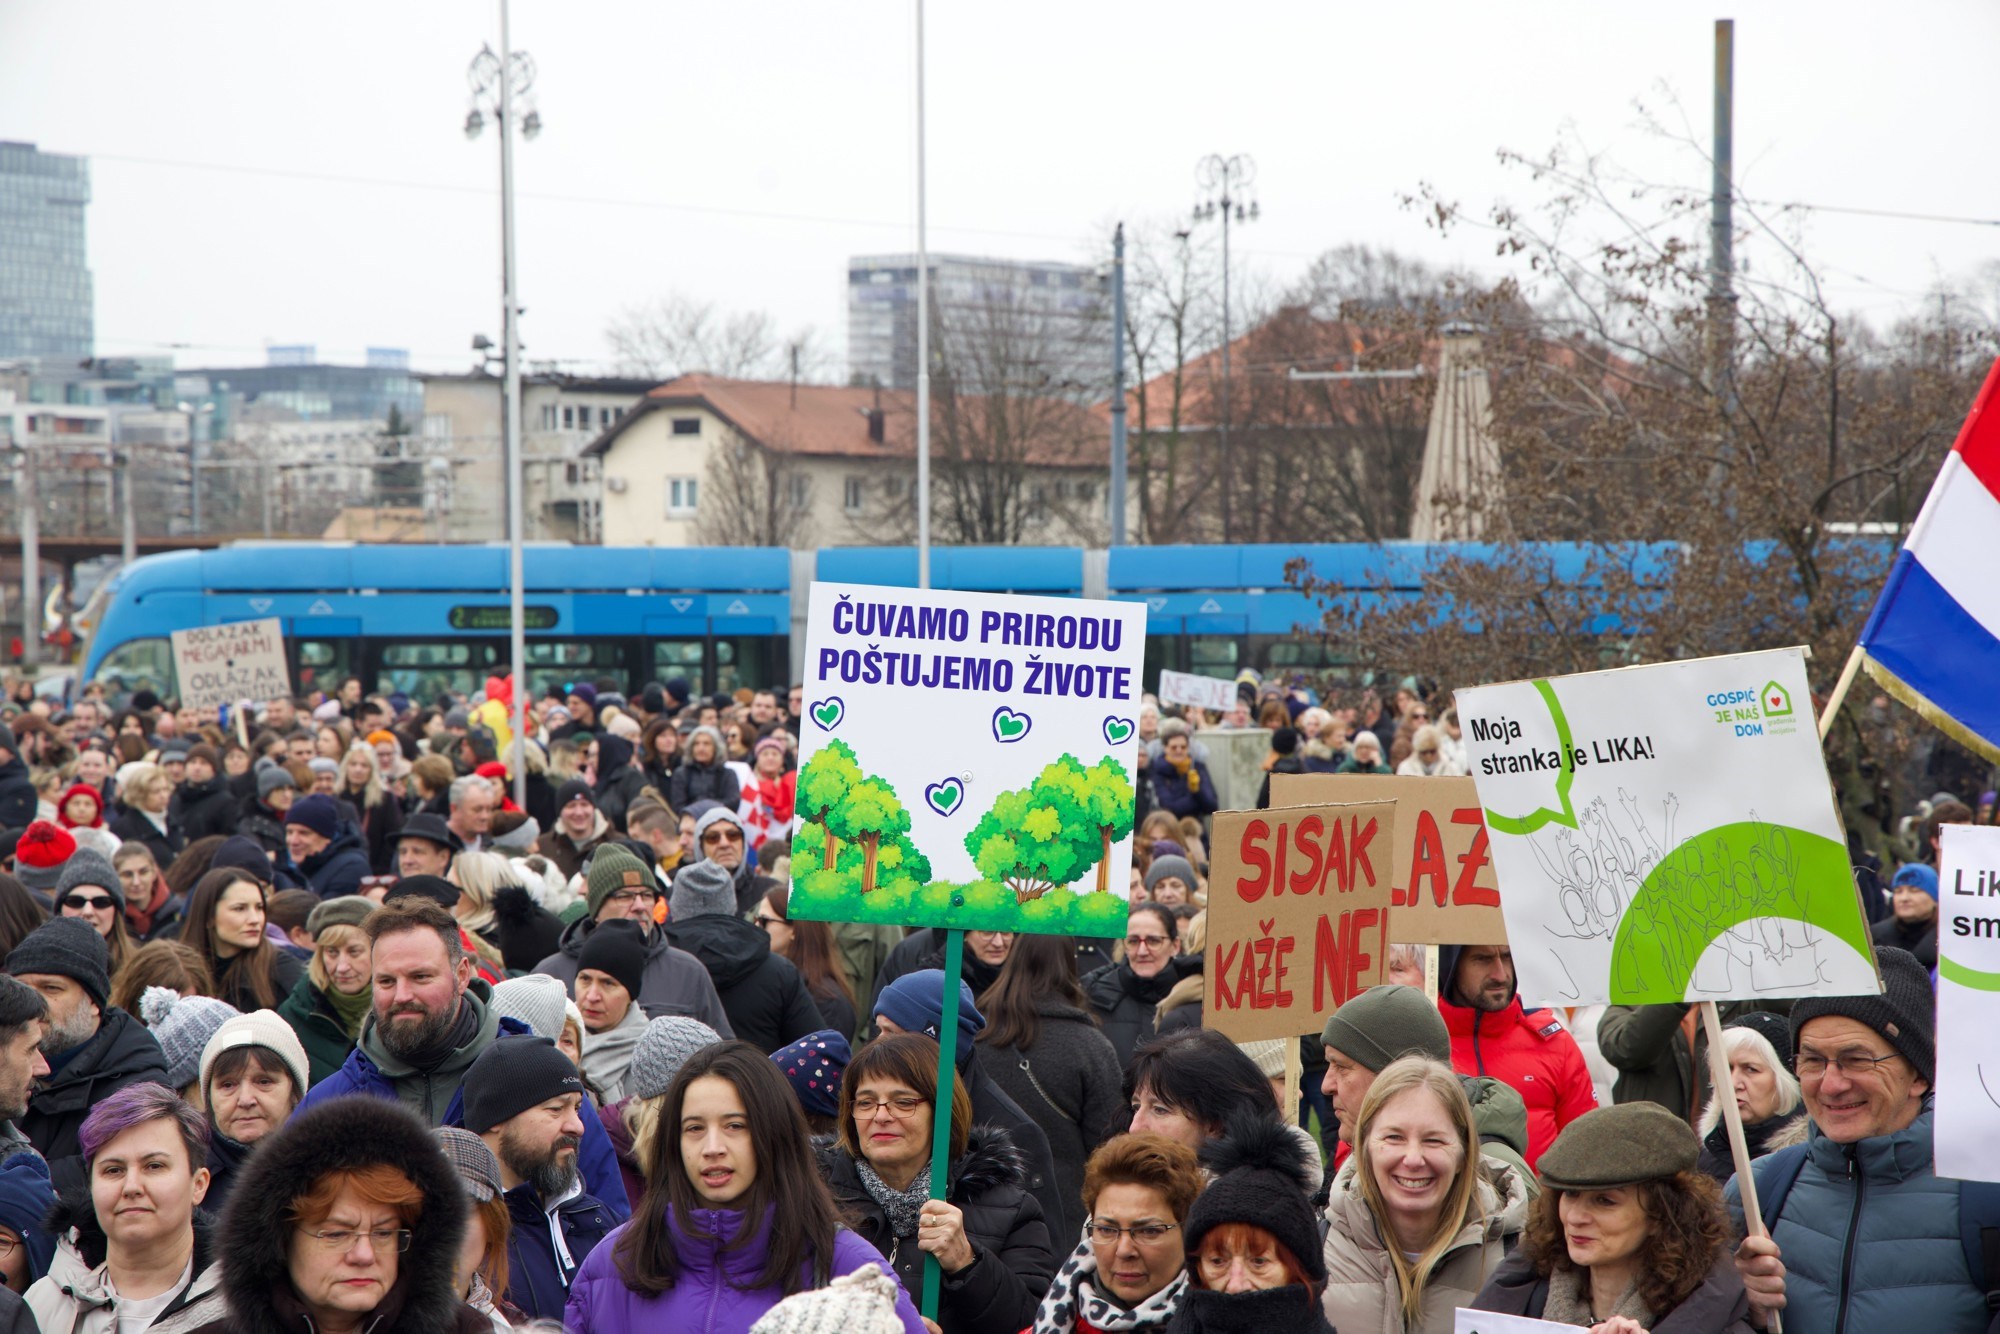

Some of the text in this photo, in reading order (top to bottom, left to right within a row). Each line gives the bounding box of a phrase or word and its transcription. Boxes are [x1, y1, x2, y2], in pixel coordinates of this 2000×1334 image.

[832, 594, 1122, 652] ČUVAMO PRIRODU
[818, 644, 1132, 700] POŠTUJEMO ŽIVOTE
[1706, 686, 1756, 707] GOSPIĆ
[1714, 704, 1760, 724] JE NAŠ
[1470, 716, 1522, 745] Moja
[1734, 723, 1764, 737] DOM
[1481, 735, 1656, 776] stranka je LIKA!
[1236, 814, 1379, 903] SISAK
[1214, 917, 1295, 1012] KAŽE
